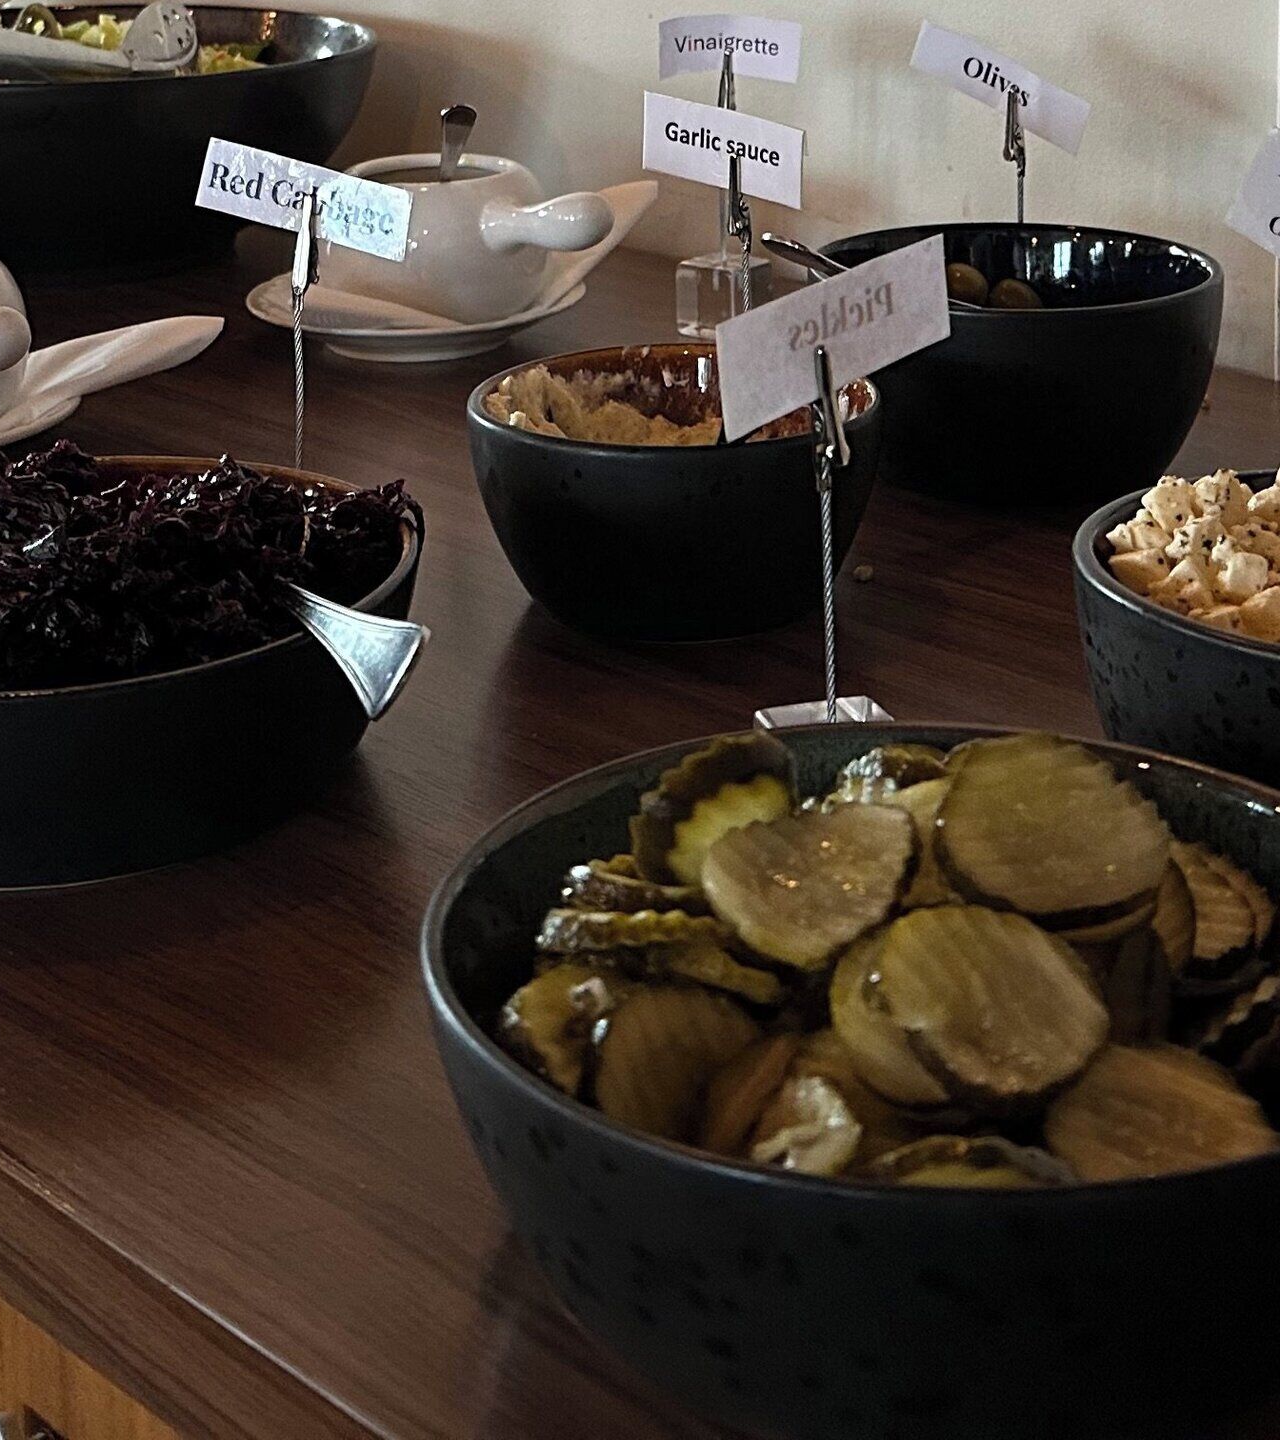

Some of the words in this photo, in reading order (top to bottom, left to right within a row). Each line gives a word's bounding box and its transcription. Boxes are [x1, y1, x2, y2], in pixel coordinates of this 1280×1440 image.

[674, 32, 779, 56] Vinaigrette
[665, 121, 721, 152] Garlic
[726, 139, 780, 166] sauce
[208, 162, 266, 200] Red
